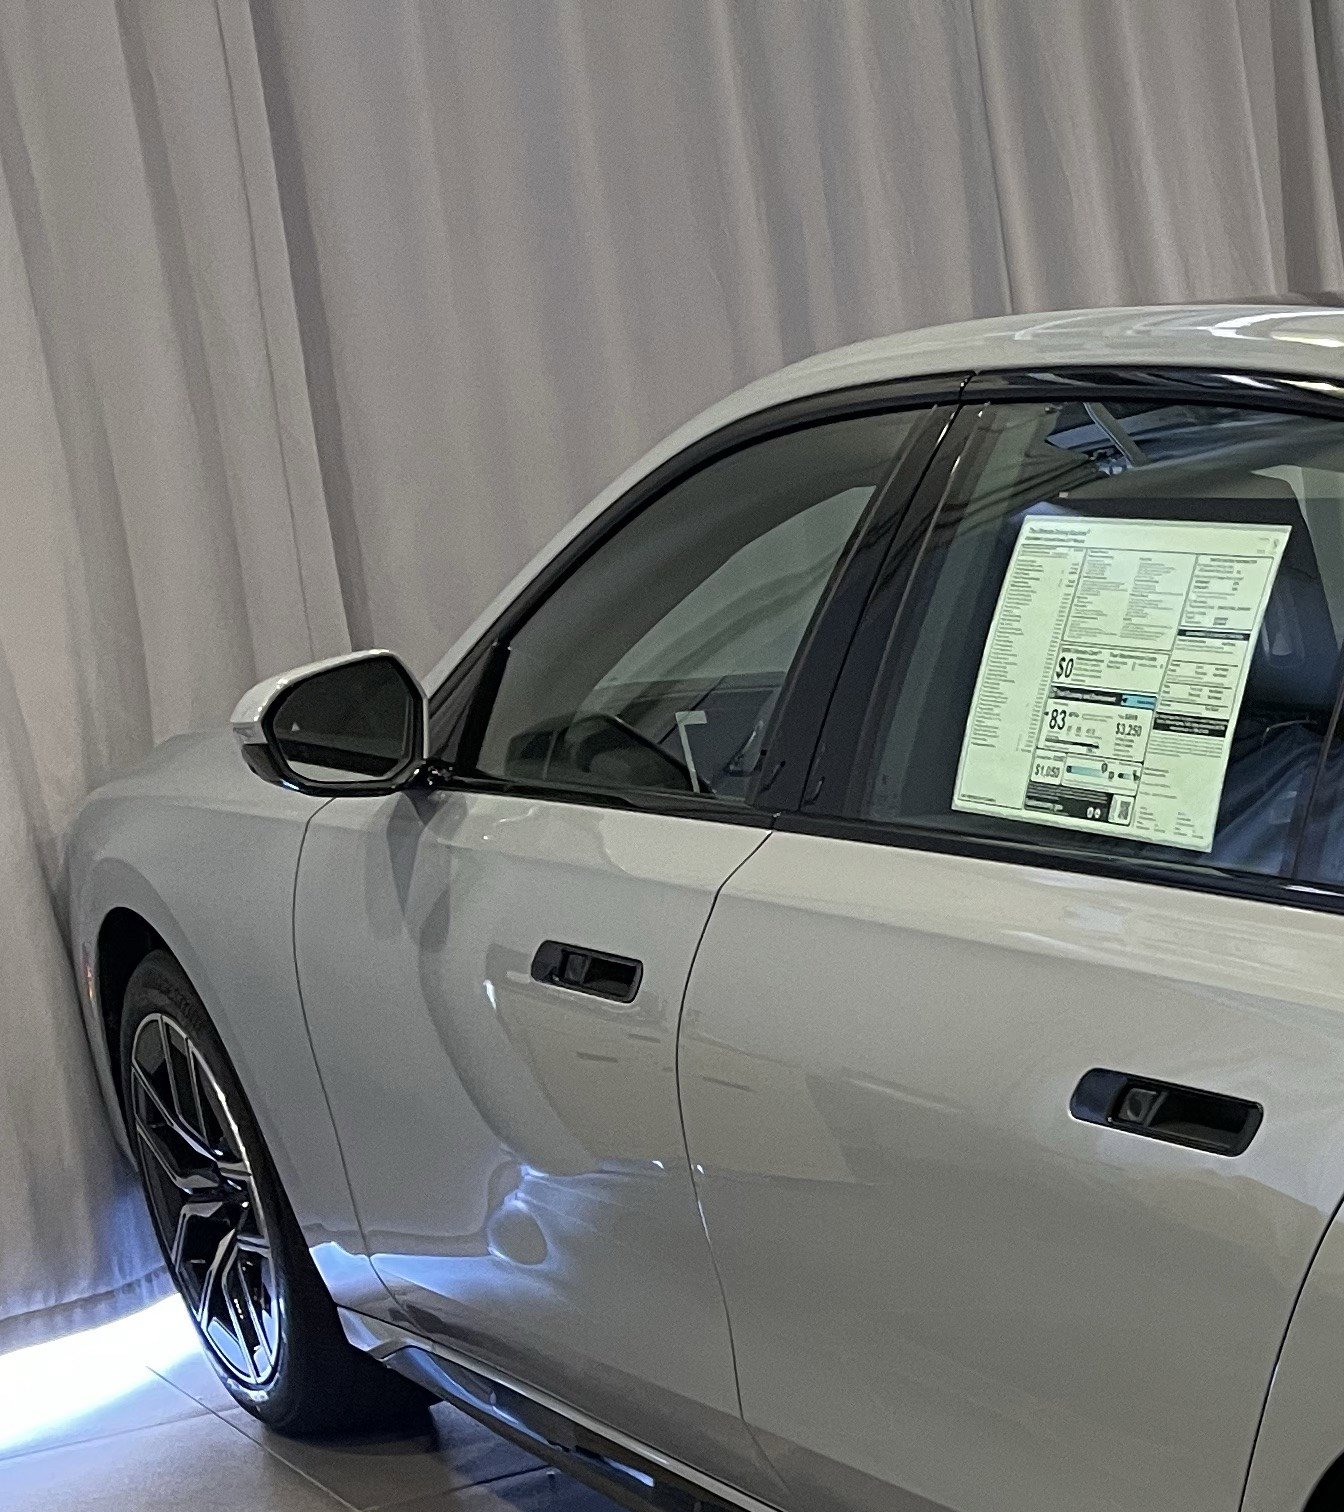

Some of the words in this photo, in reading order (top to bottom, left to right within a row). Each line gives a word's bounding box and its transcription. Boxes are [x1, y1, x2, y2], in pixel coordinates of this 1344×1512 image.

[1056, 656, 1074, 679] $0
[1049, 709, 1067, 730] 83
[1115, 722, 1142, 737] $3,250
